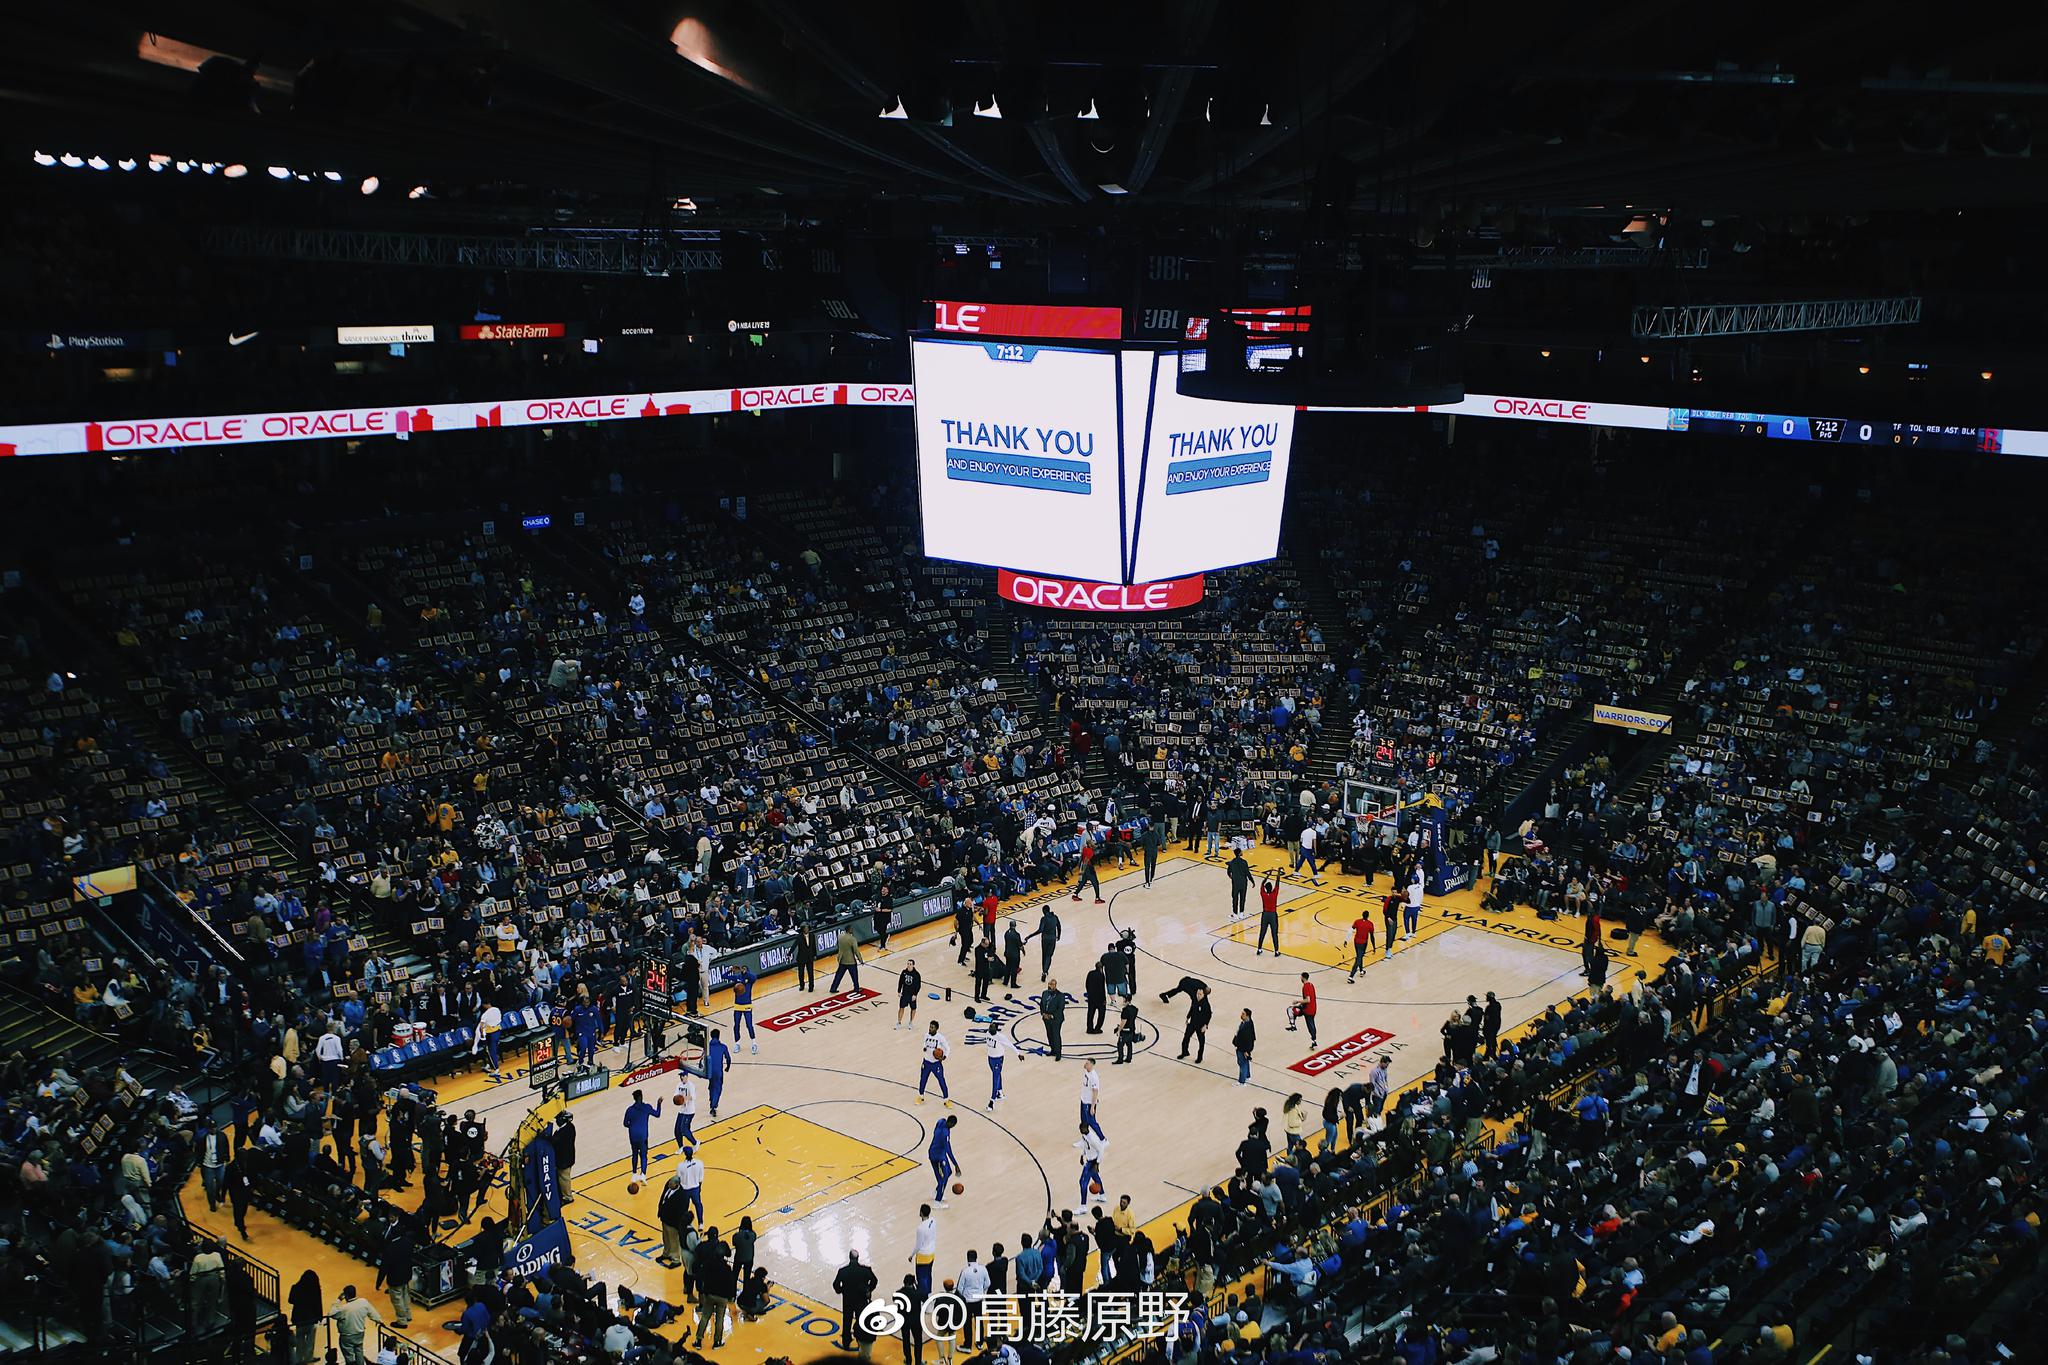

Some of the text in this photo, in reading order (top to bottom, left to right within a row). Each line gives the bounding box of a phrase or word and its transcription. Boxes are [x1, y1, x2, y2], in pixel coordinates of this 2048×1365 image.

[1144, 308, 1180, 330] JBL
[401, 330, 428, 342] thrive
[495, 325, 549, 339] State Farm
[621, 327, 654, 335] accenture
[68, 336, 125, 349] PlayStation
[996, 345, 1023, 360] 7:12
[1739, 424, 1762, 434] 7 0
[1782, 418, 1794, 435] 0
[1815, 420, 1838, 432] 7:12
[1859, 424, 1873, 441] 0
[1893, 423, 1975, 435] TF TOL REB AST BLK
[941, 420, 1093, 457] THANK YOU
[1169, 422, 1278, 458] THANK YOU
[1894, 435, 1918, 445] 0 7
[947, 458, 1092, 484] AND ENJOY YOUR EXPERIENCE
[1167, 460, 1272, 484] AND ENJOY YOUR EXPERIENCE
[522, 517, 544, 528] CHASE
[1012, 576, 1169, 610] ORACLE
[1375, 745, 1393, 761] 24
[929, 895, 951, 916] NBA App
[823, 930, 839, 951] NBA
[767, 947, 781, 969] NBA
[650, 960, 667, 976] 7:12
[646, 970, 666, 993] 24
[773, 991, 867, 1026] ORACLE
[799, 1000, 889, 1034] ARENA
[551, 1016, 562, 1026] 30
[537, 1048, 549, 1062] 24
[1303, 1032, 1382, 1071] ORACLE
[1334, 1041, 1409, 1079] ARENA
[635, 1067, 663, 1083] State Farm
[542, 1155, 552, 1201] NBA TV
[567, 1211, 665, 1261] TATE
[512, 1246, 562, 1278] ALDING
